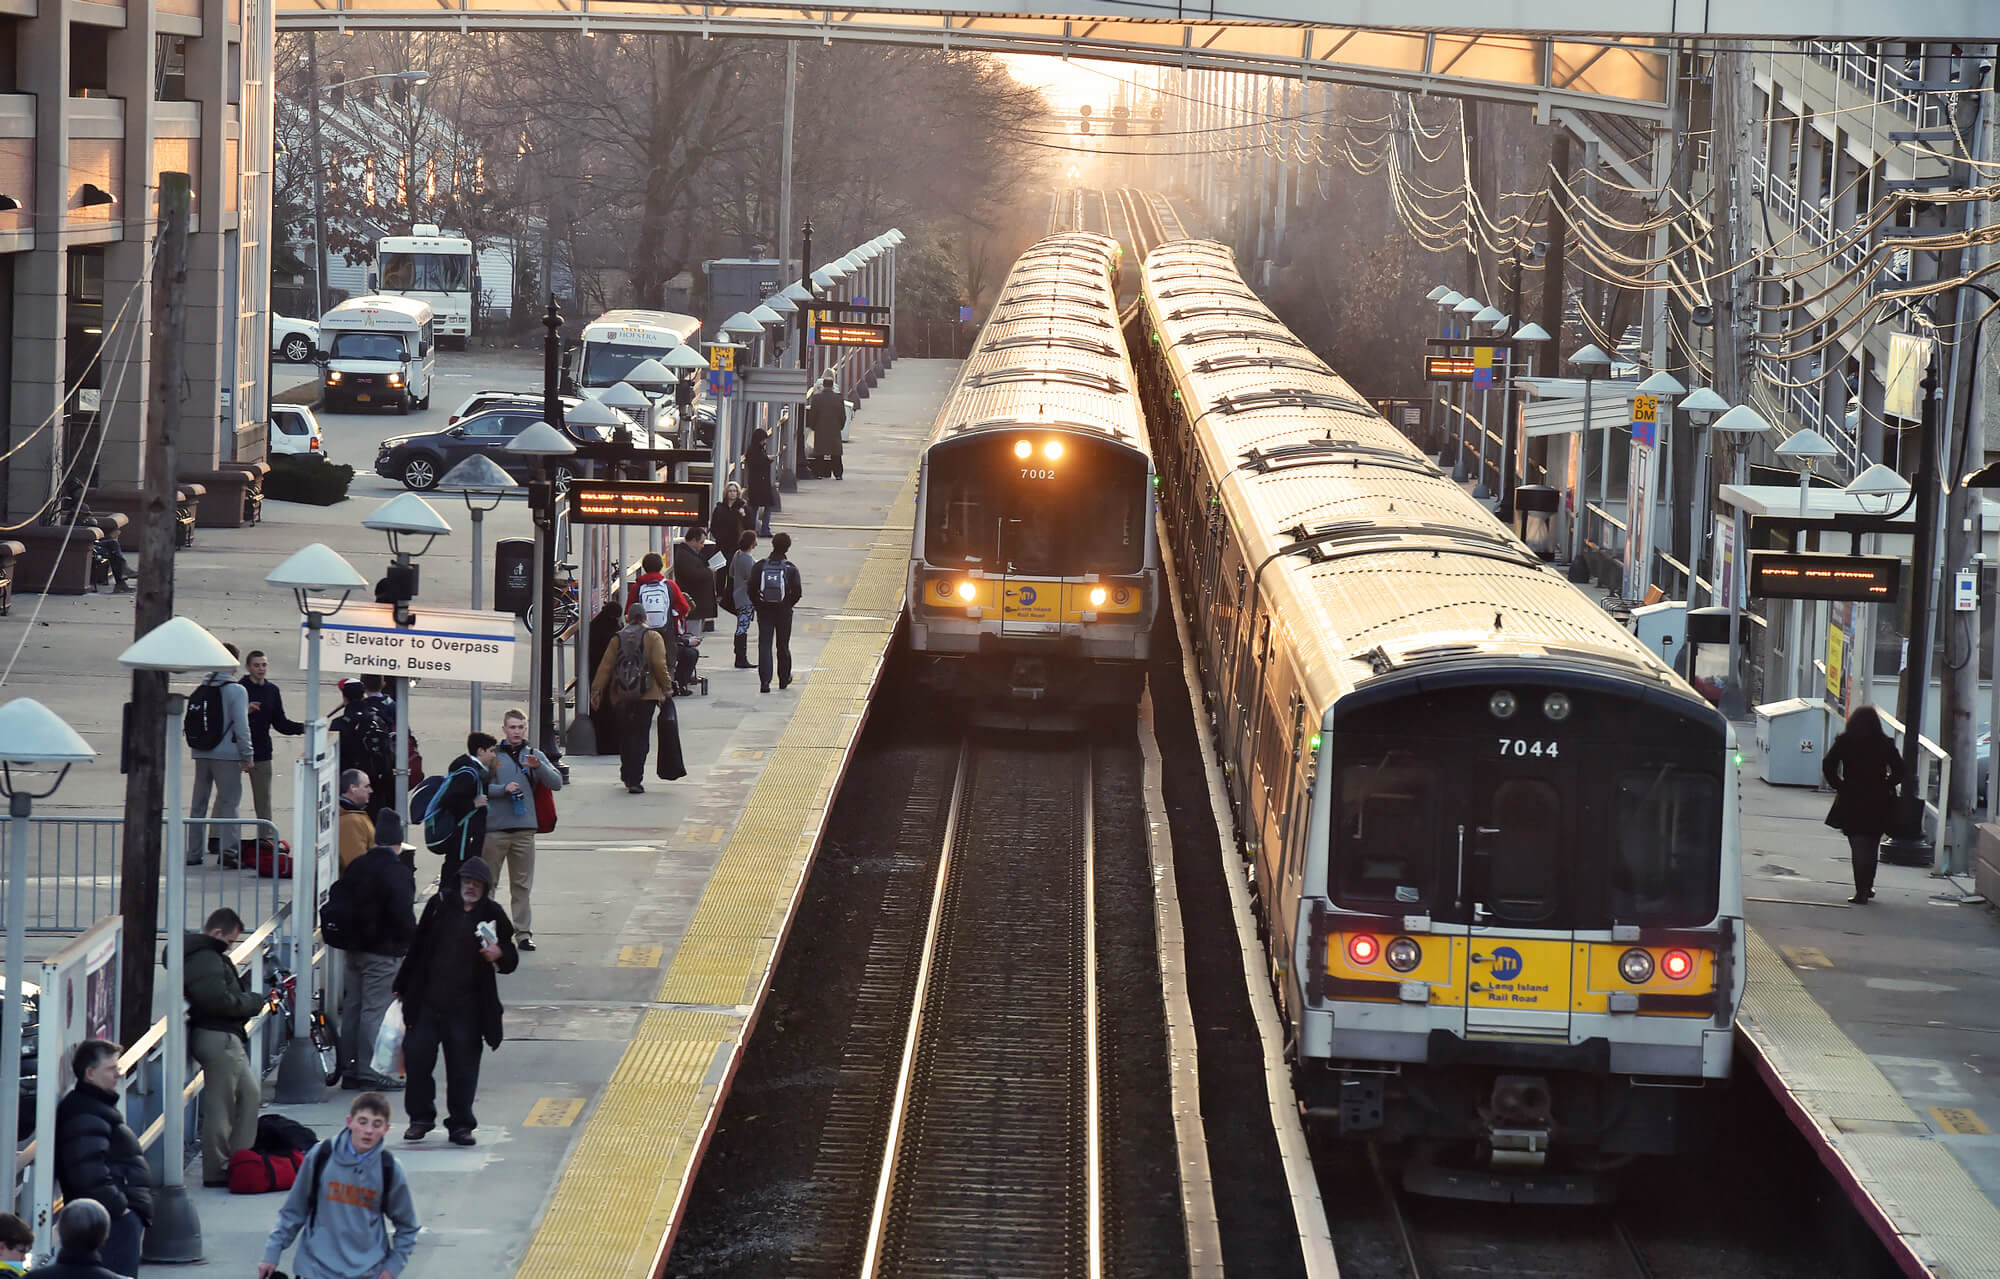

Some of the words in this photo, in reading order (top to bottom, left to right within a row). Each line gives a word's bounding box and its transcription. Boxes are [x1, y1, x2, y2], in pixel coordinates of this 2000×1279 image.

[619, 331, 657, 341] HOFSTRA
[1635, 409, 1655, 421] DM
[1020, 468, 1055, 480] 7002
[346, 632, 404, 648] Elevator
[411, 635, 425, 649] to
[432, 638, 499, 654] Overpass
[344, 653, 401, 670] Parking,
[407, 657, 452, 672] Buses
[1498, 738, 1559, 758] 7044
[1491, 955, 1518, 971] MTA
[1488, 982, 1514, 991] Long
[1517, 983, 1549, 992] Island
[1488, 993, 1508, 1001] Rail
[1511, 994, 1538, 1003] Road
